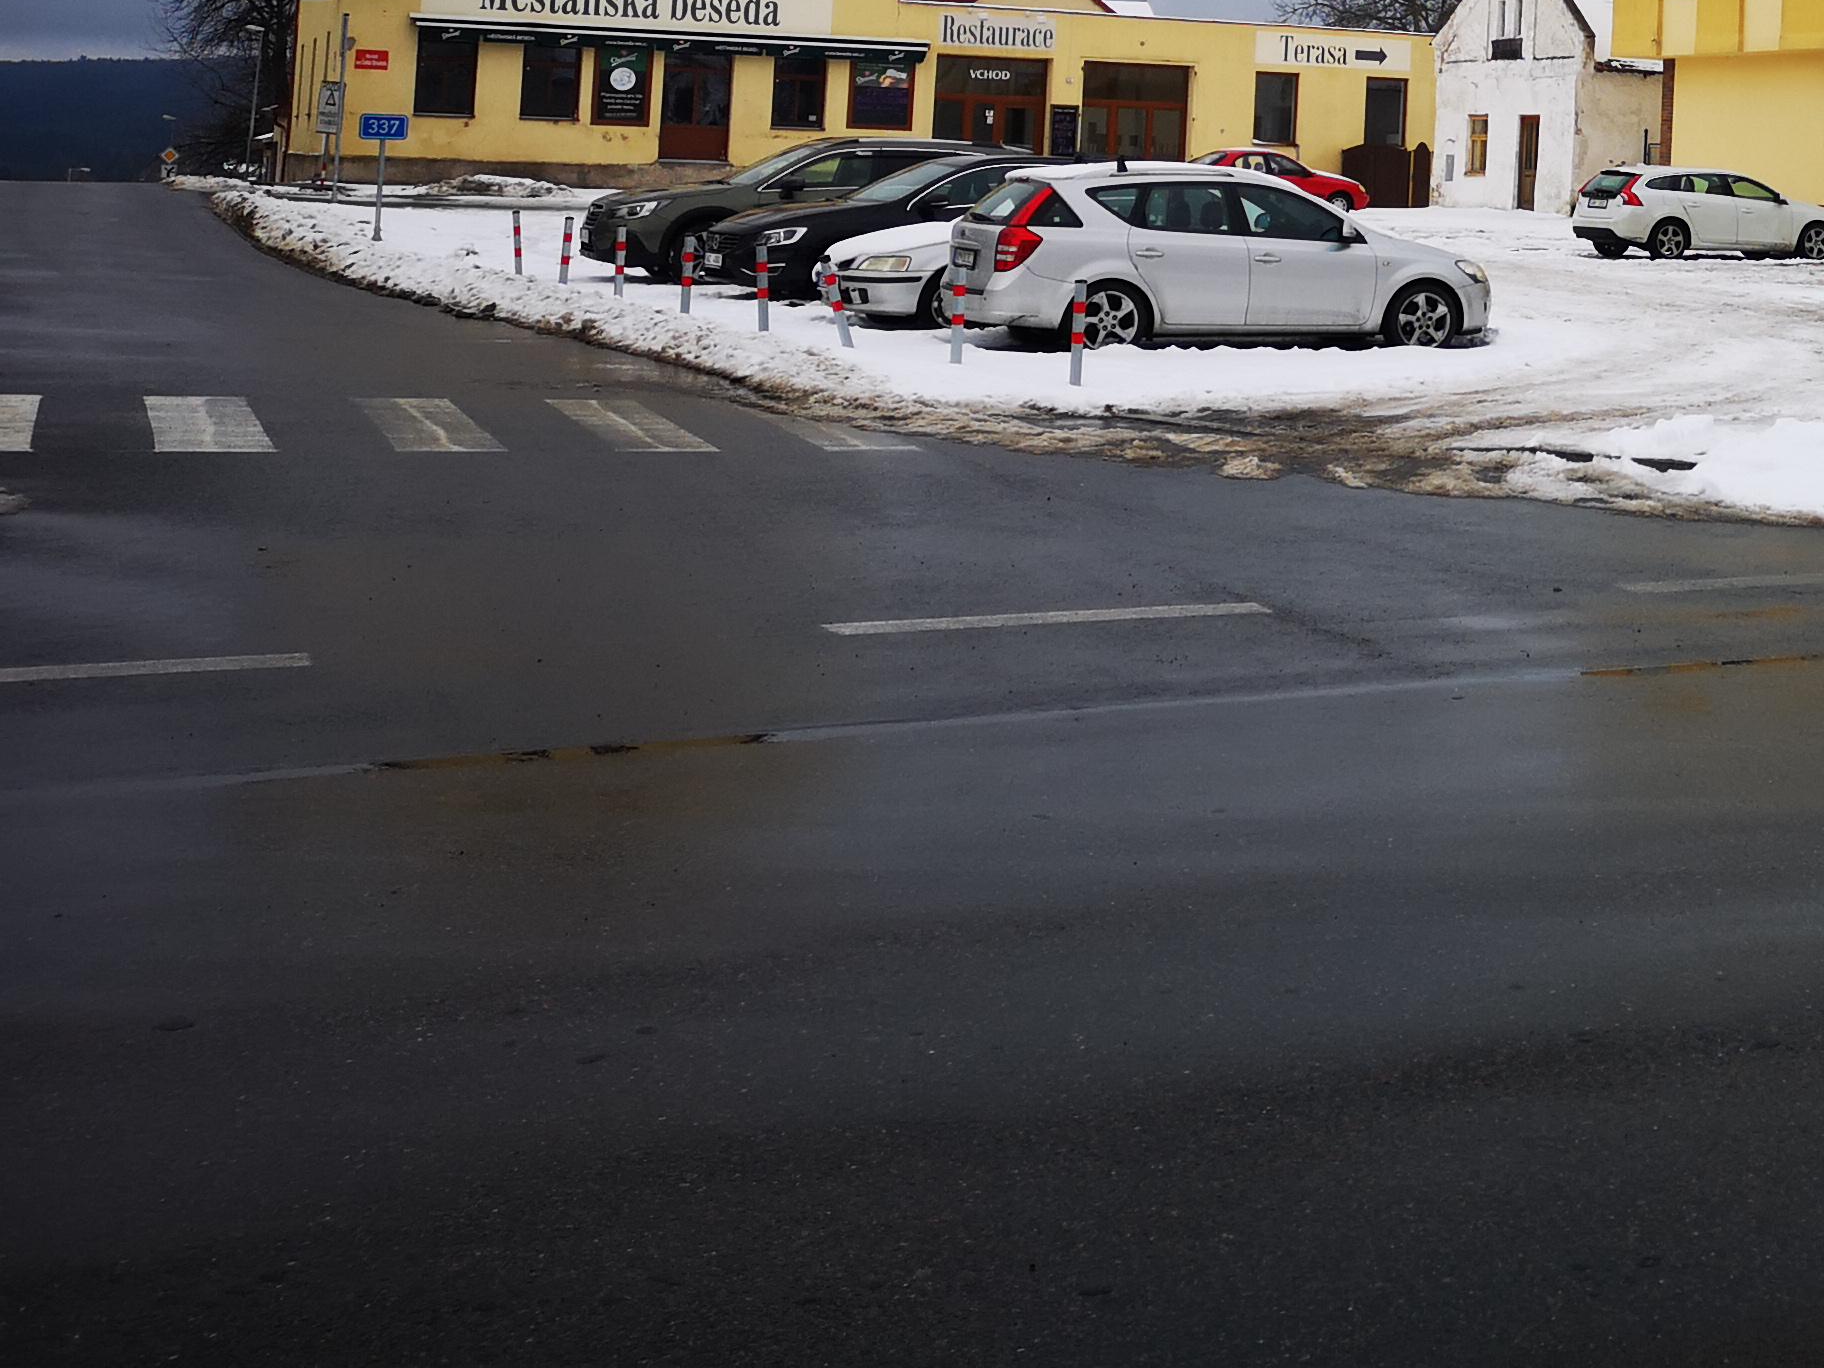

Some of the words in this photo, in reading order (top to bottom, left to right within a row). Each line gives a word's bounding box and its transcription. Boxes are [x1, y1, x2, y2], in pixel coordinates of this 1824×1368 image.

[942, 14, 1054, 49] Restaurace
[1280, 34, 1348, 66] Terasa
[969, 68, 1011, 81] VCHOD
[367, 119, 400, 134] 337
